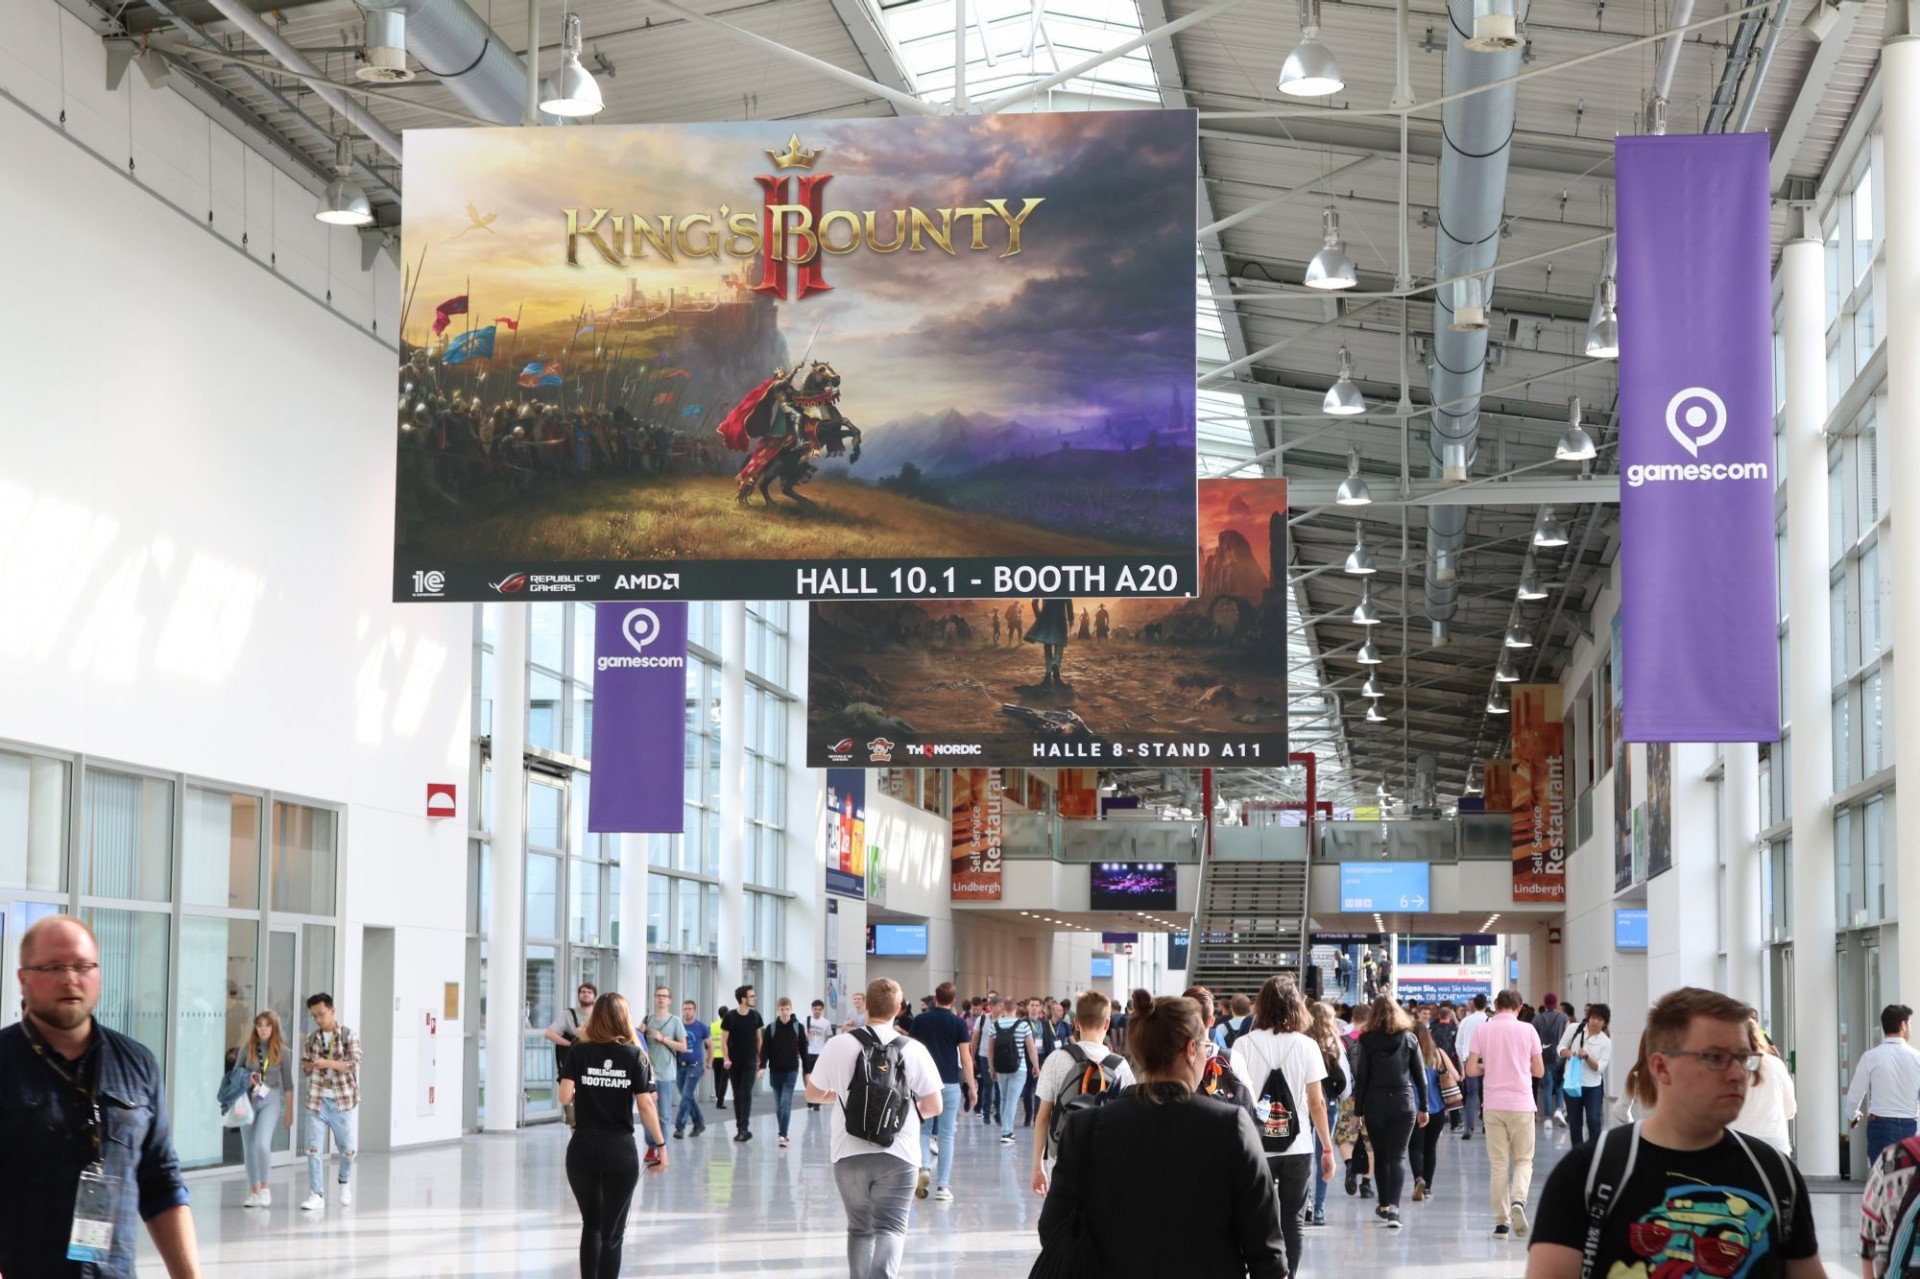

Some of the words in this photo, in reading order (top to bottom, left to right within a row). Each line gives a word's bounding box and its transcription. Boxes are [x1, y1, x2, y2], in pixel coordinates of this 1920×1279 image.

[562, 203, 763, 267] KING'S
[766, 197, 1046, 264] BOUNTY
[1627, 462, 1768, 487] gamescom
[530, 575, 584, 583] REPUBLIC
[586, 574, 601, 582] OF
[614, 574, 661, 590] AMD
[797, 568, 878, 594] HALL
[890, 566, 955, 593] 10.1
[995, 565, 1106, 592] BOOTH
[1115, 564, 1178, 592] A20
[530, 584, 576, 592] GAMERS
[597, 655, 684, 671] gamescom
[1033, 743, 1102, 757] HALLE
[1222, 743, 1261, 757] A11
[1545, 755, 1564, 875] Restaurant
[970, 805, 981, 847] Service
[1532, 806, 1543, 848] Service
[970, 852, 981, 873] Self
[1532, 851, 1543, 874] Self
[953, 882, 1001, 894] Lindbergh
[1514, 884, 1564, 896] Lindbergh
[1400, 894, 1409, 908] 6
[581, 1075, 632, 1088] BOOTCAMP
